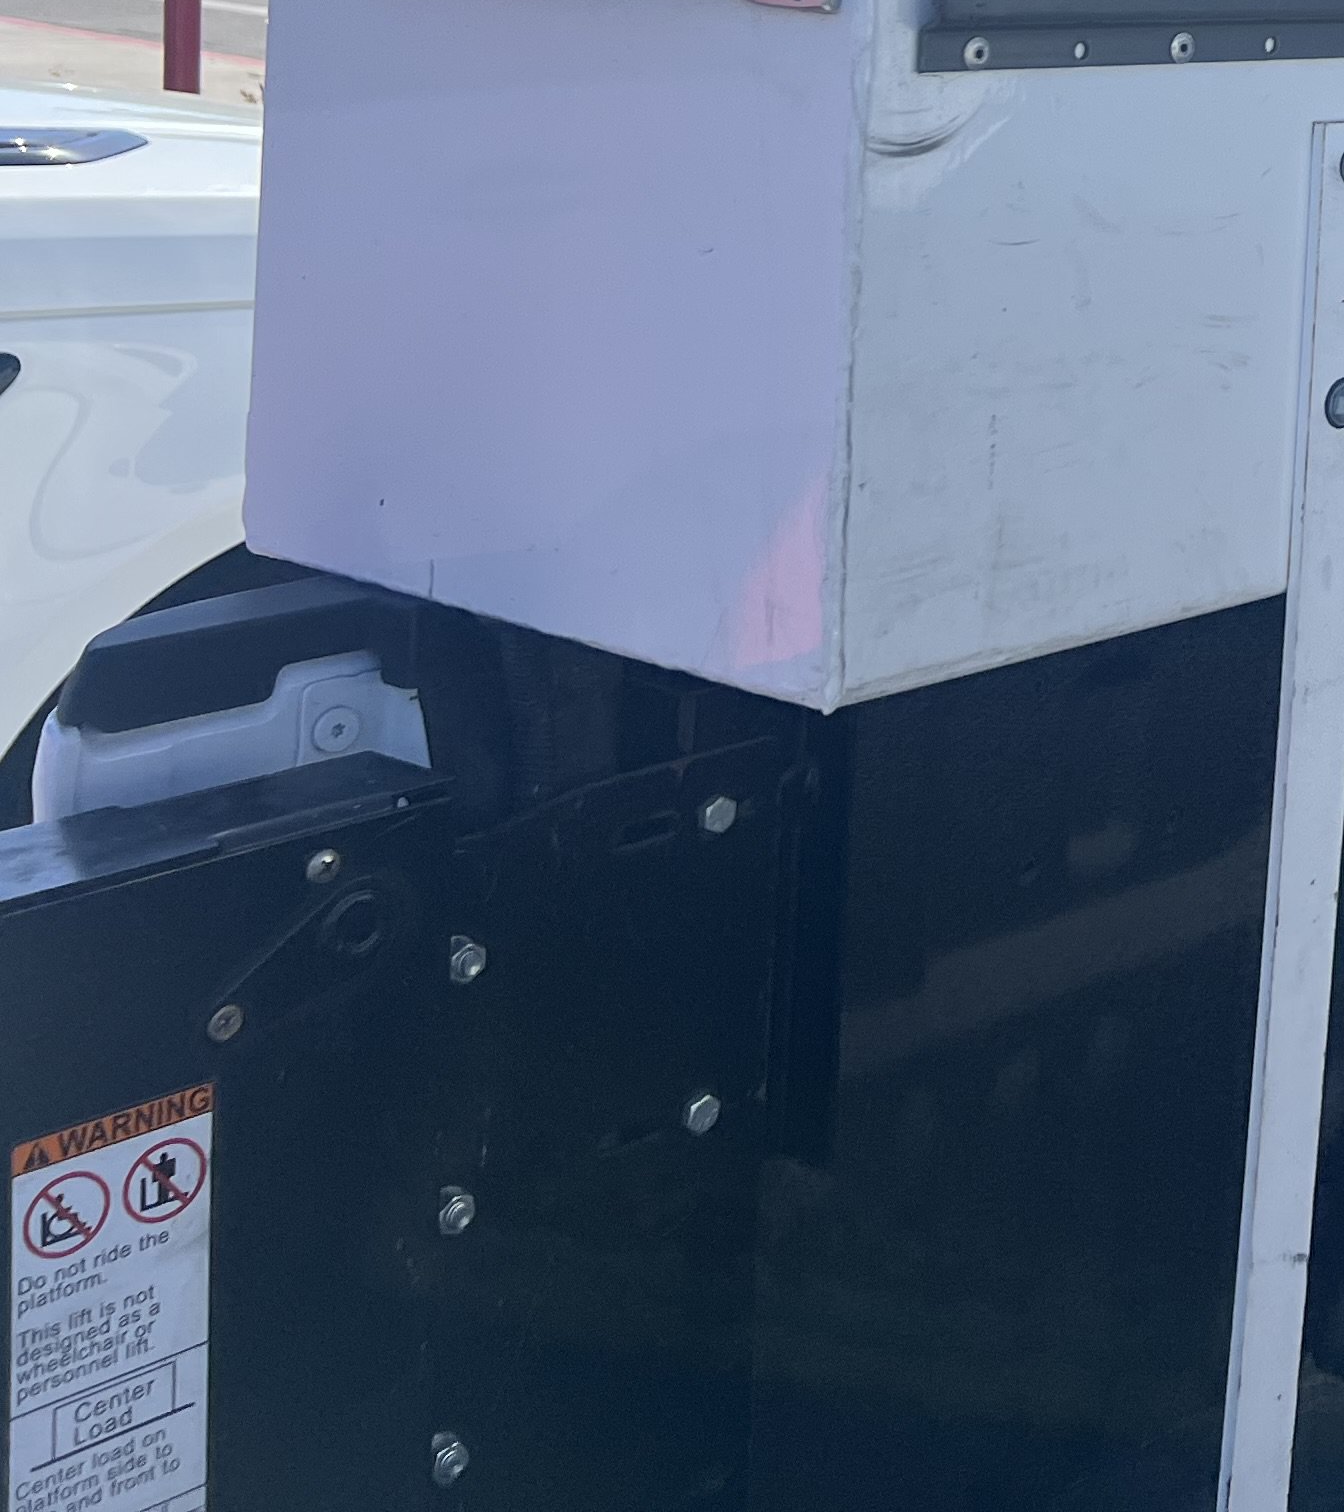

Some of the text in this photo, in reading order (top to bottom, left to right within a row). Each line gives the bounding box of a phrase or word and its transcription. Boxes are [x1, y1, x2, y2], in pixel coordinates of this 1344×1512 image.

[59, 1087, 210, 1156] WARNING
[17, 1271, 108, 1319] platform.
[18, 1230, 170, 1296] Do not ride the
[16, 1301, 161, 1367] designed as a
[18, 1285, 154, 1349] This lift is not
[16, 1319, 156, 1385] wheelchair or
[17, 1338, 156, 1407] personnel lift.
[73, 1406, 133, 1446] Load
[74, 1378, 157, 1423] Center
[16, 1428, 167, 1501] Center load on
[106, 1454, 147, 1480] side
[155, 1443, 173, 1460] to
[109, 1466, 155, 1497] front
[162, 1458, 181, 1475] to
